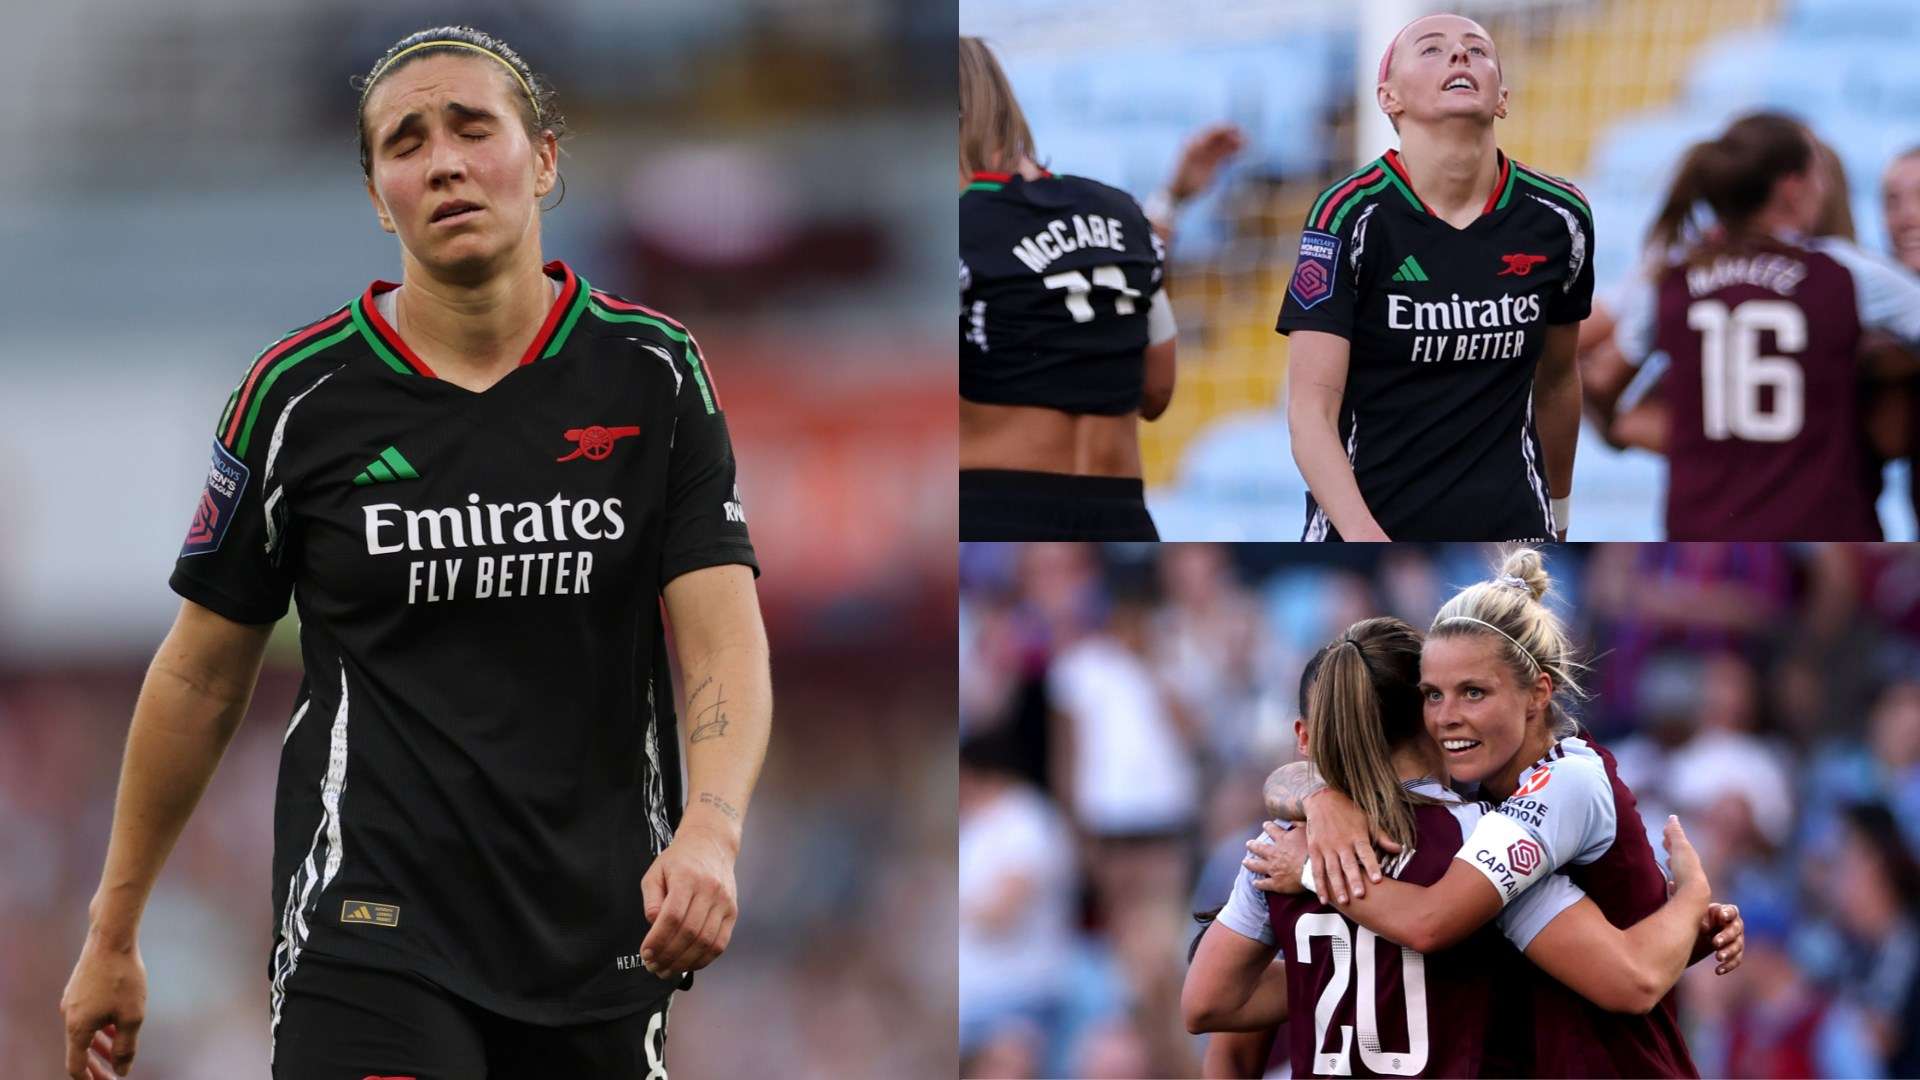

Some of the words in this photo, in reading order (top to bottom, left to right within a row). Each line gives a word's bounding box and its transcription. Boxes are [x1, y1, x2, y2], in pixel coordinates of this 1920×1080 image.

[1387, 293, 1540, 330] Emirates
[1411, 335, 1448, 363] FLY
[1453, 330, 1525, 361] BETTER
[1687, 299, 1808, 442] 16
[362, 492, 624, 555] Emirates
[408, 558, 463, 604] FLY
[475, 551, 593, 599] BETTER
[1497, 806, 1543, 827] ATION
[1295, 912, 1429, 1077] 20
